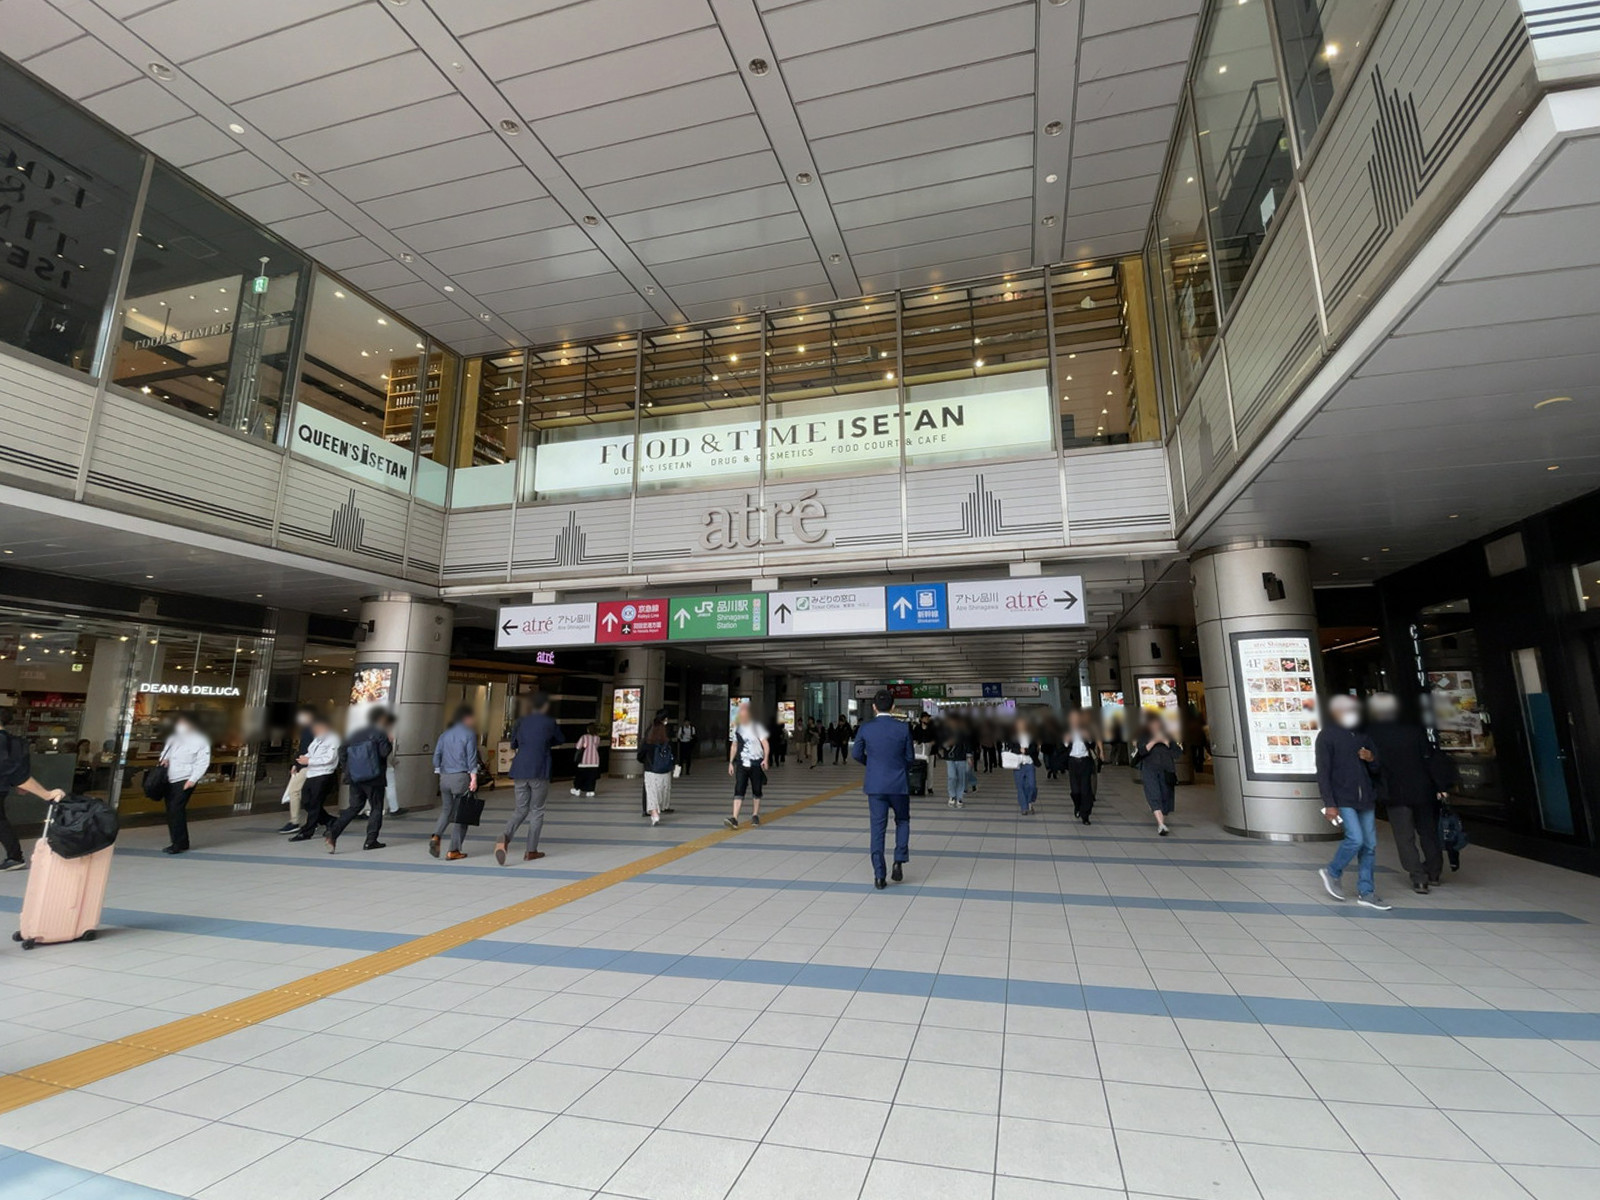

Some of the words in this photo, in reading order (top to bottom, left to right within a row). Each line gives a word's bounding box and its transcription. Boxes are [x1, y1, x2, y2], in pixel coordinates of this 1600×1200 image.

[599, 437, 690, 465] FOOD
[701, 433, 723, 454] &
[727, 421, 827, 452] TIME
[298, 424, 359, 462] QUEEN'S
[360, 443, 408, 481] ISETAN
[613, 464, 655, 476] QUEN'S
[658, 461, 692, 472] ISETAN
[711, 456, 737, 466] DRUG
[744, 454, 751, 463] &
[757, 448, 814, 461] CSMETICS
[831, 443, 859, 454] FOOD
[864, 439, 899, 451] COURT
[906, 437, 912, 446] &
[918, 434, 947, 445] CAFE
[699, 488, 828, 550] atré
[811, 594, 856, 604] みどりの窓口
[955, 592, 999, 604] アトレ品川
[1005, 590, 1049, 609] atré
[695, 601, 714, 613] JR
[717, 599, 749, 613] 品川駅
[558, 614, 591, 624] アトレ品川
[716, 613, 749, 621] Shinagawa
[522, 616, 553, 633] atré
[716, 621, 738, 630] Station
[1246, 658, 1261, 669] 4F
[140, 683, 178, 693] DEAN
[180, 685, 190, 694] &
[192, 686, 240, 696] DELUCA
